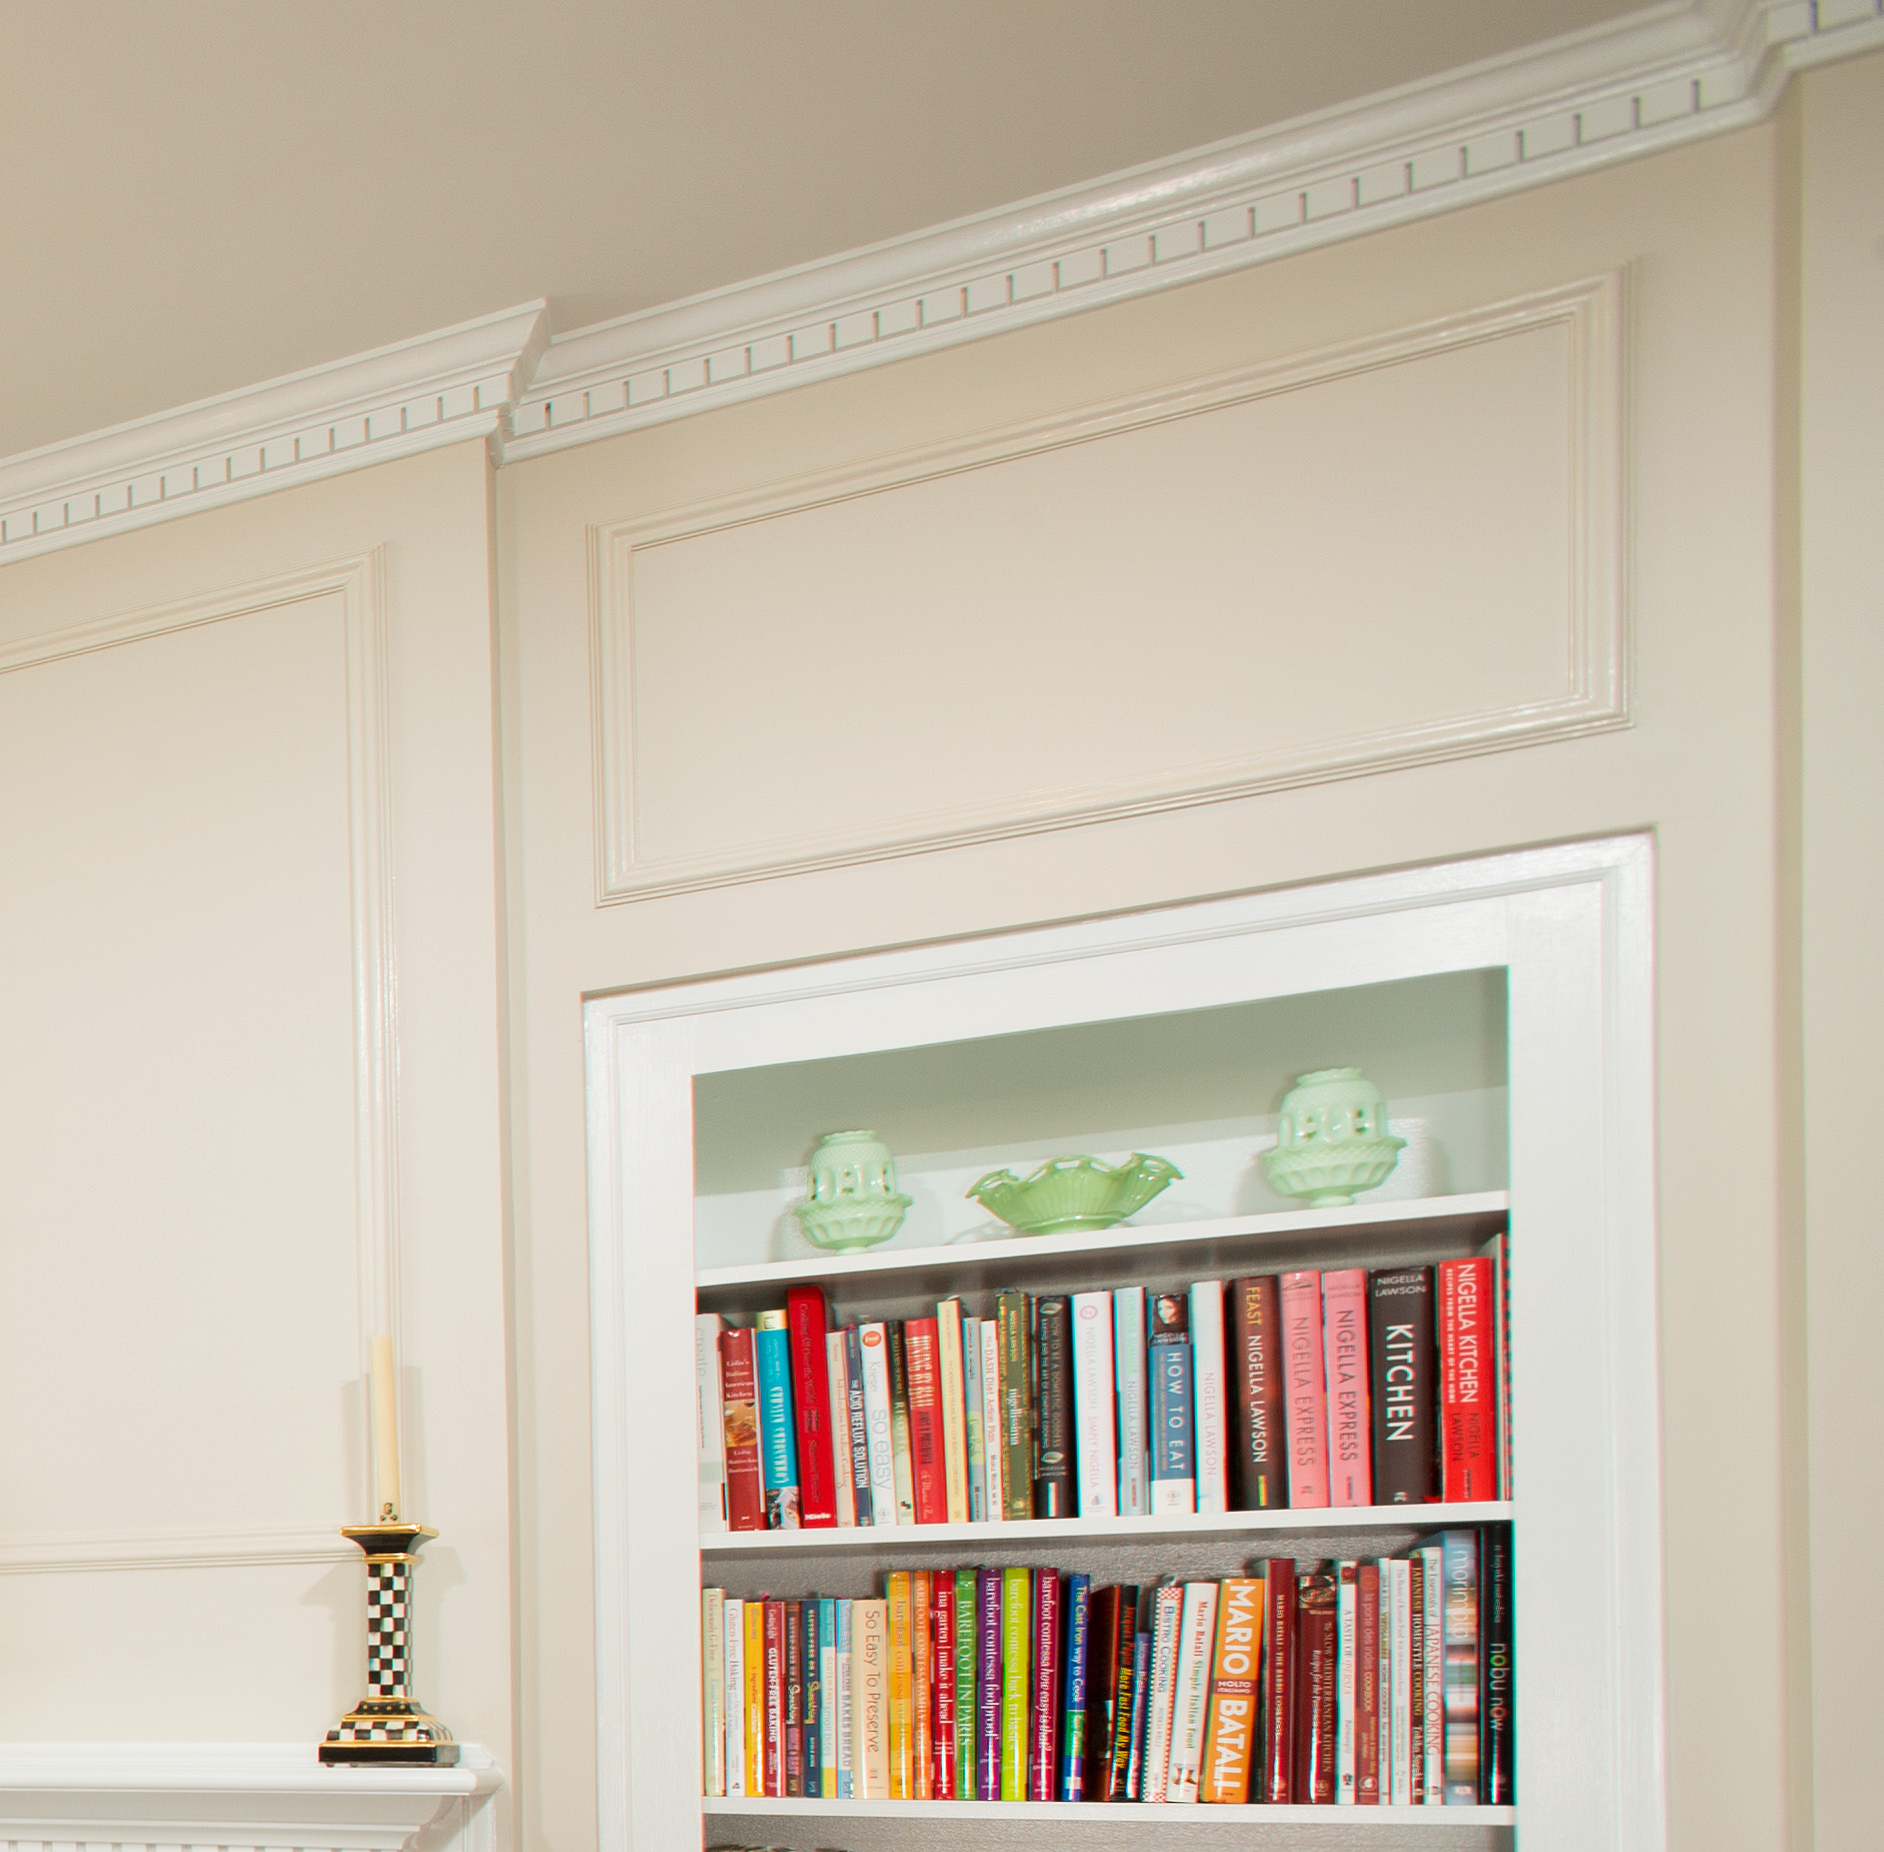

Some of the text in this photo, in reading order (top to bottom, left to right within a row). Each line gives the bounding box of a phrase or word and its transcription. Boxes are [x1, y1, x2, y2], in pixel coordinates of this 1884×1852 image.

[1375, 1285, 1427, 1297] LAWSON
[1377, 1274, 1425, 1285] NIGELLA
[1051, 1317, 1060, 1336] HOW
[1446, 1297, 1454, 1317] FROM
[1052, 1338, 1061, 1349] TO
[1457, 1263, 1479, 1403] NIGELLA KITCHEN
[1245, 1286, 1267, 1463] FEAST NIGELLA LAWSON
[1385, 1324, 1415, 1441] KITCHEN
[1447, 1358, 1455, 1367] OF
[1447, 1369, 1455, 1382] THE
[984, 1349, 996, 1443] DASH Diet Action Plan
[1053, 1371, 1061, 1410] DOMESTIC
[1127, 1381, 1137, 1421] NIGELLA
[1291, 1316, 1315, 1467] NIGELLA EXPRESS
[1335, 1309, 1359, 1462] NIGELLA EXPRESS
[1448, 1383, 1456, 1403] HOME
[1006, 1388, 1022, 1446] nigellissima
[1085, 1326, 1100, 1488] NIGELLA LAWSON SIMPLY NIGELLA
[1166, 1351, 1186, 1471] HOW TO EAT
[1204, 1372, 1217, 1476] NIGELLA LAWSON
[849, 1390, 868, 1489] ACID REFLUX SOLUTION
[872, 1409, 892, 1490] so easy
[1053, 1412, 1062, 1448] GODDESS
[1128, 1426, 1138, 1470] LAWSON
[1451, 1412, 1464, 1461] LAWSON
[1468, 1412, 1481, 1458] NIGELLA
[938, 1591, 951, 1608] ina
[1074, 1605, 1085, 1625] Cast
[1075, 1585, 1086, 1603] The
[1362, 1603, 1374, 1626] porte
[1364, 1593, 1375, 1601] la
[1451, 1551, 1473, 1638] morimoto
[916, 1580, 926, 1683] BAREFOOT CONTESSA
[934, 1611, 952, 1643] garten
[1009, 1579, 1024, 1715] barefoot contessa back to
[1034, 1576, 1056, 1711] barefoot contessa how easy
[1074, 1627, 1085, 1645] Iron
[1276, 1595, 1284, 1668] MARIO BATALI THE
[1342, 1618, 1352, 1644] TASTE
[1364, 1628, 1374, 1644] des
[1412, 1567, 1421, 1716] JAPANESE HOMESTYLE COOKING
[727, 1608, 739, 1691] Gluten-Free Baking
[808, 1661, 815, 1671] ON
[895, 1601, 907, 1700] barefoot contessa
[938, 1652, 953, 1680] make
[980, 1577, 1000, 1740] barefoot contessa foolproof
[1070, 1647, 1083, 1664] way
[1157, 1606, 1174, 1693] BISTRO COOKING
[1309, 1649, 1321, 1673] Recipes
[1343, 1646, 1352, 1657] OF
[1364, 1646, 1375, 1670] indes
[1424, 1559, 1440, 1755] The Essentials of JAPANESE COOKING
[768, 1647, 777, 1708] GLUTEN-FREE
[864, 1610, 882, 1753] So Easy To Preserve
[958, 1601, 974, 1746] BAREFOOT IN PARIS
[1072, 1678, 1082, 1703] Cook
[1073, 1666, 1082, 1676] to
[1185, 1601, 1208, 1749] Mario Batali Simple Italian Food
[1213, 1585, 1256, 1788] MARIO BATALI
[1342, 1660, 1352, 1696] PERSIA
[1364, 1671, 1373, 1712] COOKBOOK
[1489, 1643, 1509, 1731] nobu now
[785, 1685, 800, 1724] Shoestring
[804, 1681, 820, 1724] Shoestring
[841, 1695, 851, 1729] BAKES
[938, 1693, 954, 1724] ahead
[1114, 1667, 1133, 1769] More Fast Food My Way
[1322, 1632, 1333, 1772] SLOW MEDITERRANEAN KITCHEN
[768, 1708, 777, 1743] BAKING
[842, 1731, 851, 1768] BREAD
